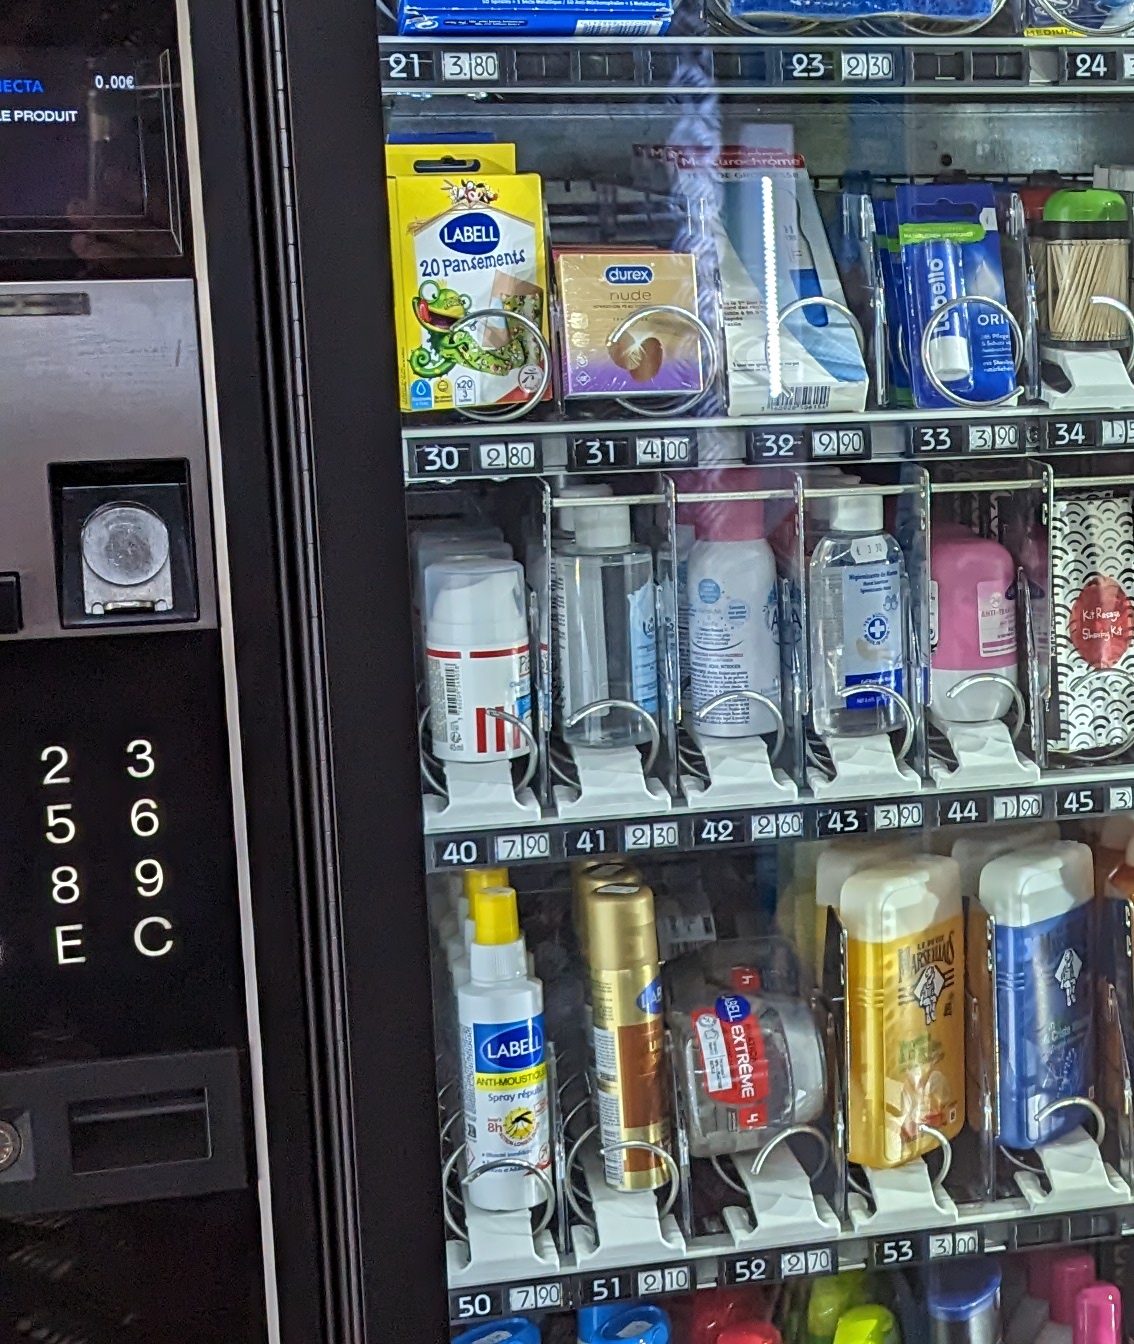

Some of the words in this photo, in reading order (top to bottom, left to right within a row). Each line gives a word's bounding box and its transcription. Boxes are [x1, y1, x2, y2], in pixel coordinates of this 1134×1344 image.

[389, 53, 421, 78] 21
[792, 54, 825, 77] 23
[1076, 54, 1107, 77] 24
[13, 108, 78, 123] PRODUIT
[444, 225, 498, 243] LABELL
[420, 260, 441, 277] 20
[443, 249, 526, 277] Pansements
[608, 267, 650, 283] durex
[610, 289, 651, 301] nude
[921, 429, 951, 451] 33
[424, 446, 459, 470] 30
[1081, 609, 1094, 621] Kit
[1110, 625, 1123, 637] Kit
[41, 745, 71, 785] 2
[126, 739, 155, 778] 3
[1064, 789, 1094, 811] 45
[45, 803, 76, 844] 5
[130, 798, 159, 837] 6
[828, 810, 858, 832] 43
[443, 838, 477, 861] 40
[51, 865, 80, 904] 8
[134, 859, 164, 897] 9
[55, 923, 86, 965] E
[133, 916, 174, 957] C
[487, 1035, 541, 1059] LABELL
[731, 1024, 754, 1098] EXTRÊME
[488, 1092, 515, 1103] Spray
[884, 1241, 913, 1262] 53
[458, 1294, 491, 1318] 50
